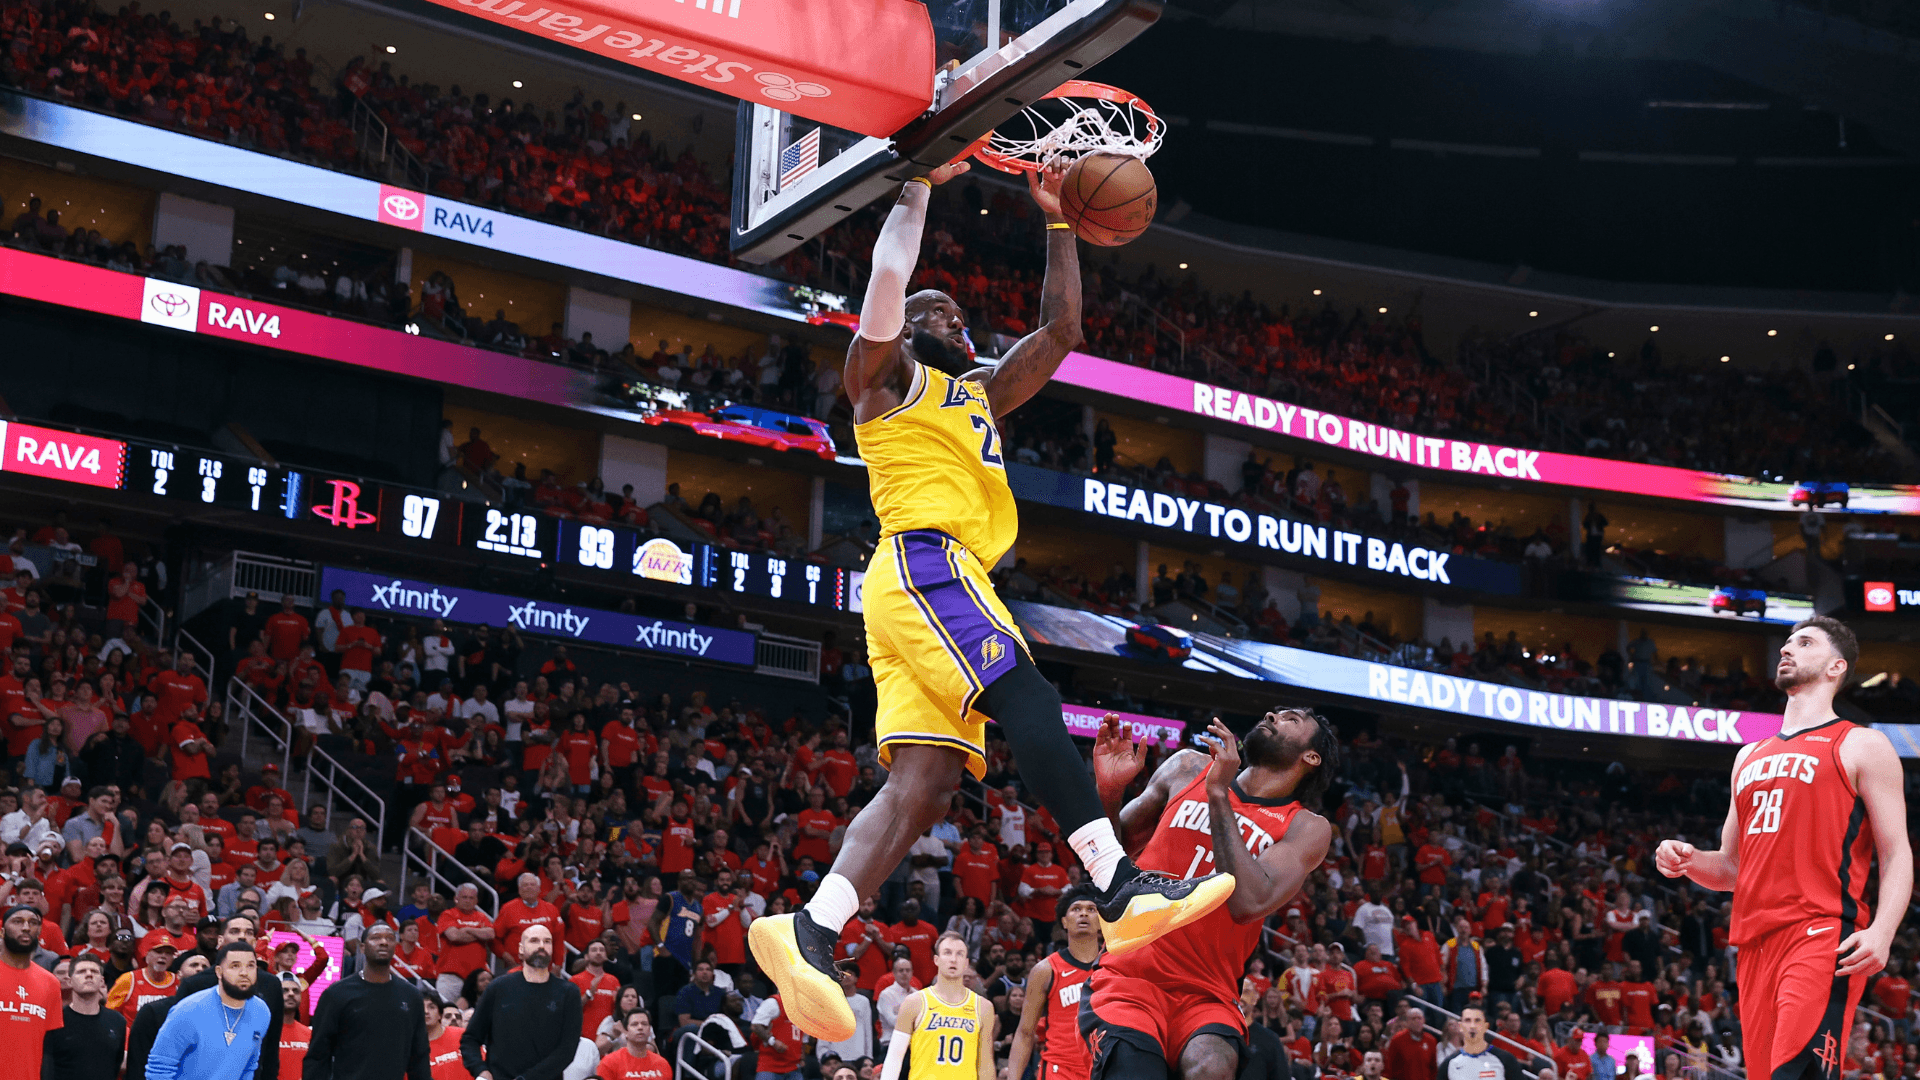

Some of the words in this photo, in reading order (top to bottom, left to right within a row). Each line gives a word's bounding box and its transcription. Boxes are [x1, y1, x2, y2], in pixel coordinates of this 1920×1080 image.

[433, 207, 495, 238] RAV4
[208, 302, 281, 338] RAV4
[1193, 382, 1297, 434] READY
[1300, 408, 1344, 445] TO
[1348, 420, 1411, 462] RUN
[1416, 436, 1446, 467] IT
[1451, 442, 1541, 481] BACK
[17, 436, 101, 474] RAV4
[151, 449, 174, 470] TOL
[199, 458, 222, 478] FLS
[248, 467, 267, 486] CC
[153, 469, 168, 495] 2
[201, 477, 216, 503] 3
[251, 485, 261, 511] 1
[402, 494, 439, 539] 97
[485, 509, 537, 548] 2:13
[1084, 478, 1200, 533] READY
[1203, 503, 1252, 543] TO
[1257, 514, 1327, 560] RUN
[1333, 530, 1362, 566] IT
[1366, 537, 1451, 585] BACK
[579, 525, 615, 569] 93
[731, 552, 749, 569] TOL
[768, 558, 786, 576] FLS
[806, 565, 820, 582] CC
[371, 580, 459, 618] xfinity
[733, 568, 746, 592] 2
[771, 575, 782, 598] 3
[809, 581, 816, 604] 1
[1896, 589, 1920, 605] TU
[507, 601, 590, 637] xfinity
[635, 621, 713, 656] xfinity
[1062, 711, 1104, 730] ENERG
[1369, 664, 1475, 713] READY
[1478, 683, 1523, 721] TO
[1528, 693, 1602, 732] RUN
[1608, 700, 1641, 734] IT
[1646, 703, 1744, 744] BACK
[1736, 752, 1820, 796] ROCKETS
[1169, 799, 1275, 860] ROCETS
[1747, 788, 1784, 835] 28
[1183, 844, 1216, 880] 1
[684, 919, 694, 937] 8
[20, 1002, 47, 1020] FIRE
[926, 1013, 975, 1033] LAKERS
[937, 1035, 964, 1066] 10
